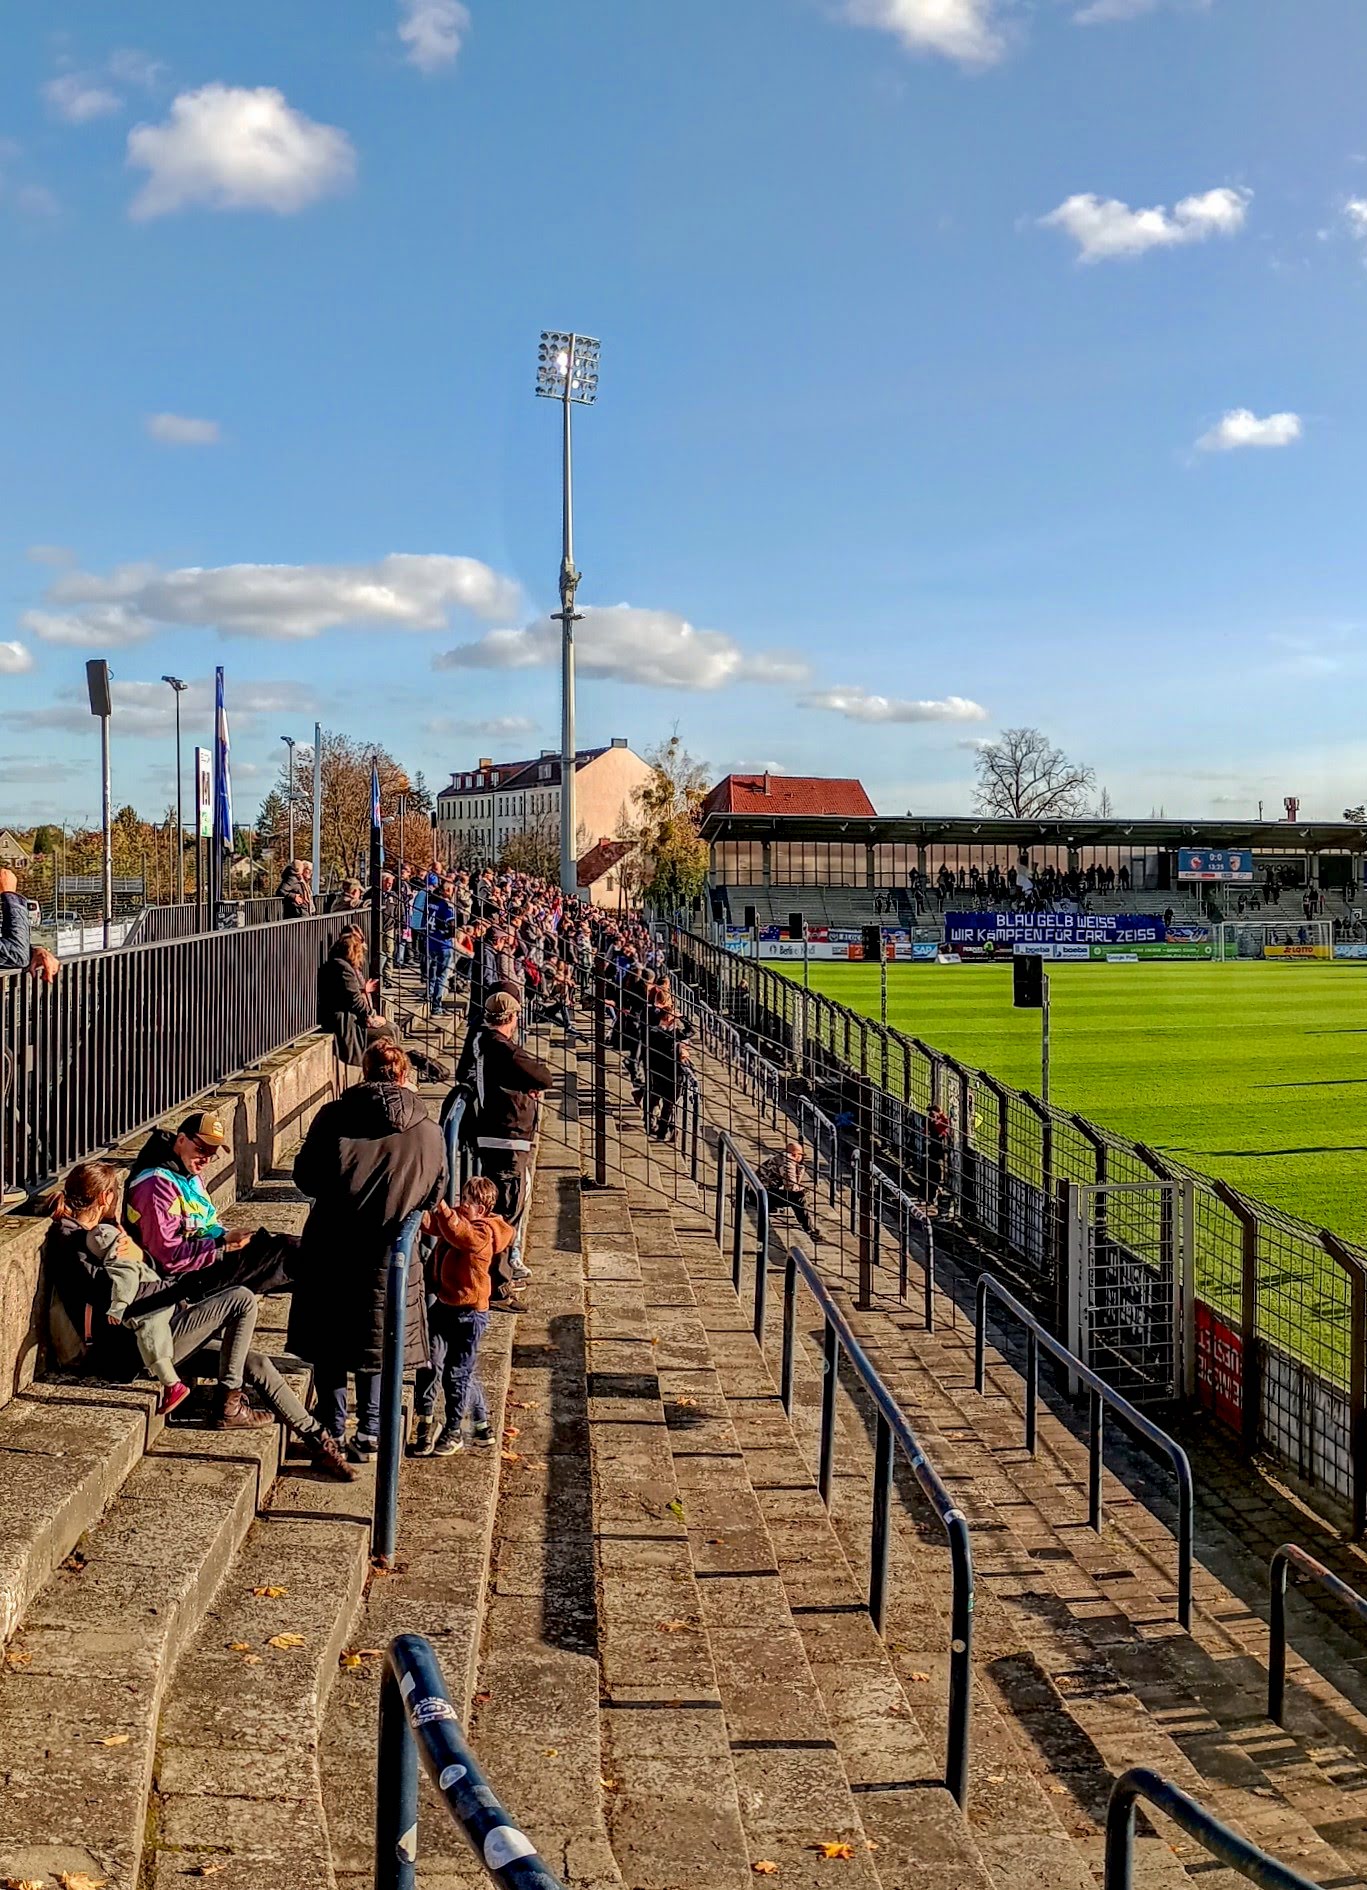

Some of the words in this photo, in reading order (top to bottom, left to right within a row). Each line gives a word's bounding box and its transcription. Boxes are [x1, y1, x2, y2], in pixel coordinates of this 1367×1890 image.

[1209, 853, 1223, 861] 0:0
[996, 914, 1034, 927] BLAU
[1037, 914, 1074, 927] GELB
[1077, 916, 1116, 929] WEISS
[951, 928, 974, 941] WIR
[1076, 930, 1112, 942] CARL
[1116, 928, 1156, 942] ZEISS
[912, 946, 932, 954] SAP
